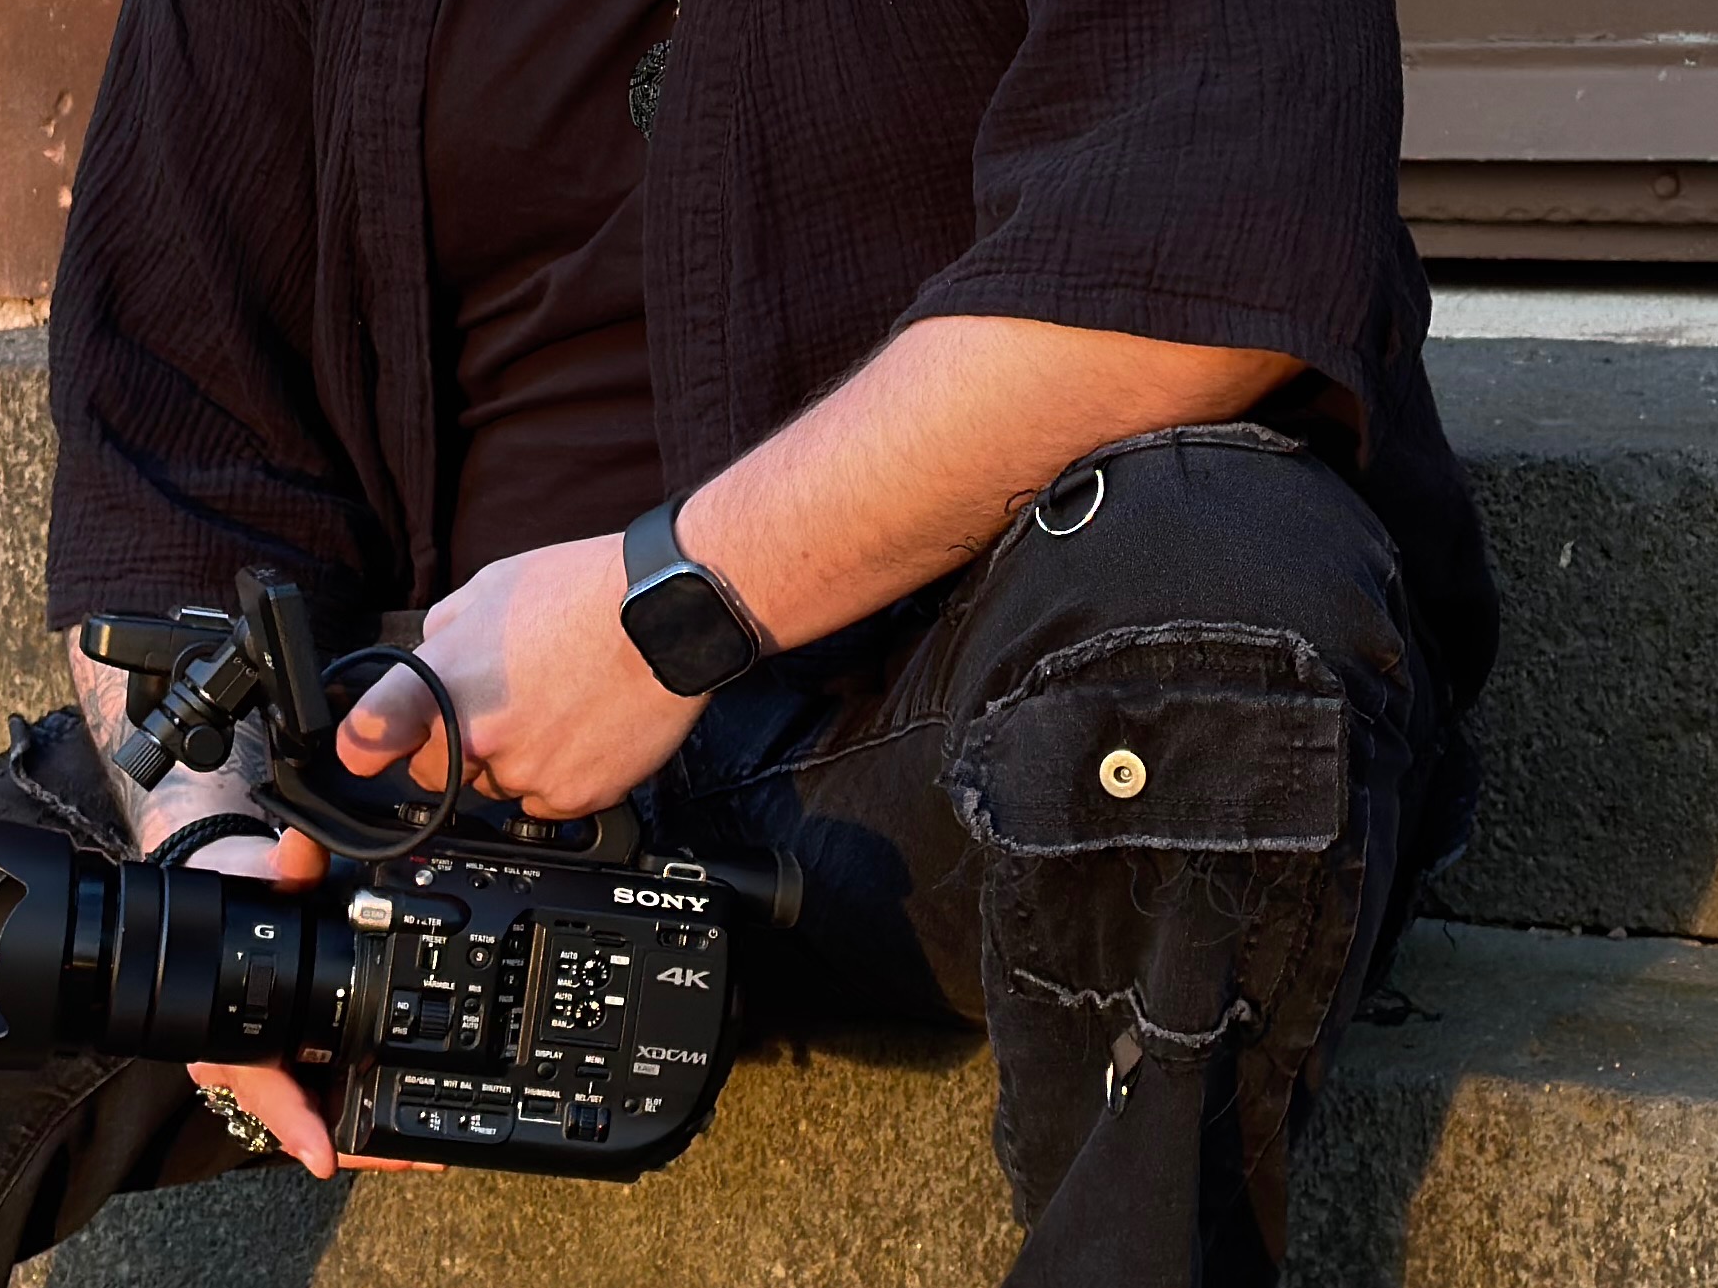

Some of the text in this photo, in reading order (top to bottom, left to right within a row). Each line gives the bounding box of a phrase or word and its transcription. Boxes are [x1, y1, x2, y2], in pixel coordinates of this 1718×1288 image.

[613, 887, 710, 912] SONY
[404, 915, 415, 924] ND
[254, 924, 275, 939] G
[469, 934, 496, 944] STATUS
[475, 952, 484, 962] 3
[656, 967, 711, 990] 4K
[397, 1001, 410, 1010] ND
[535, 1049, 563, 1060] DISPLAY
[584, 1055, 605, 1065] MENU
[636, 1045, 708, 1066] XDCAM
[482, 1083, 512, 1094] SHUTTER
